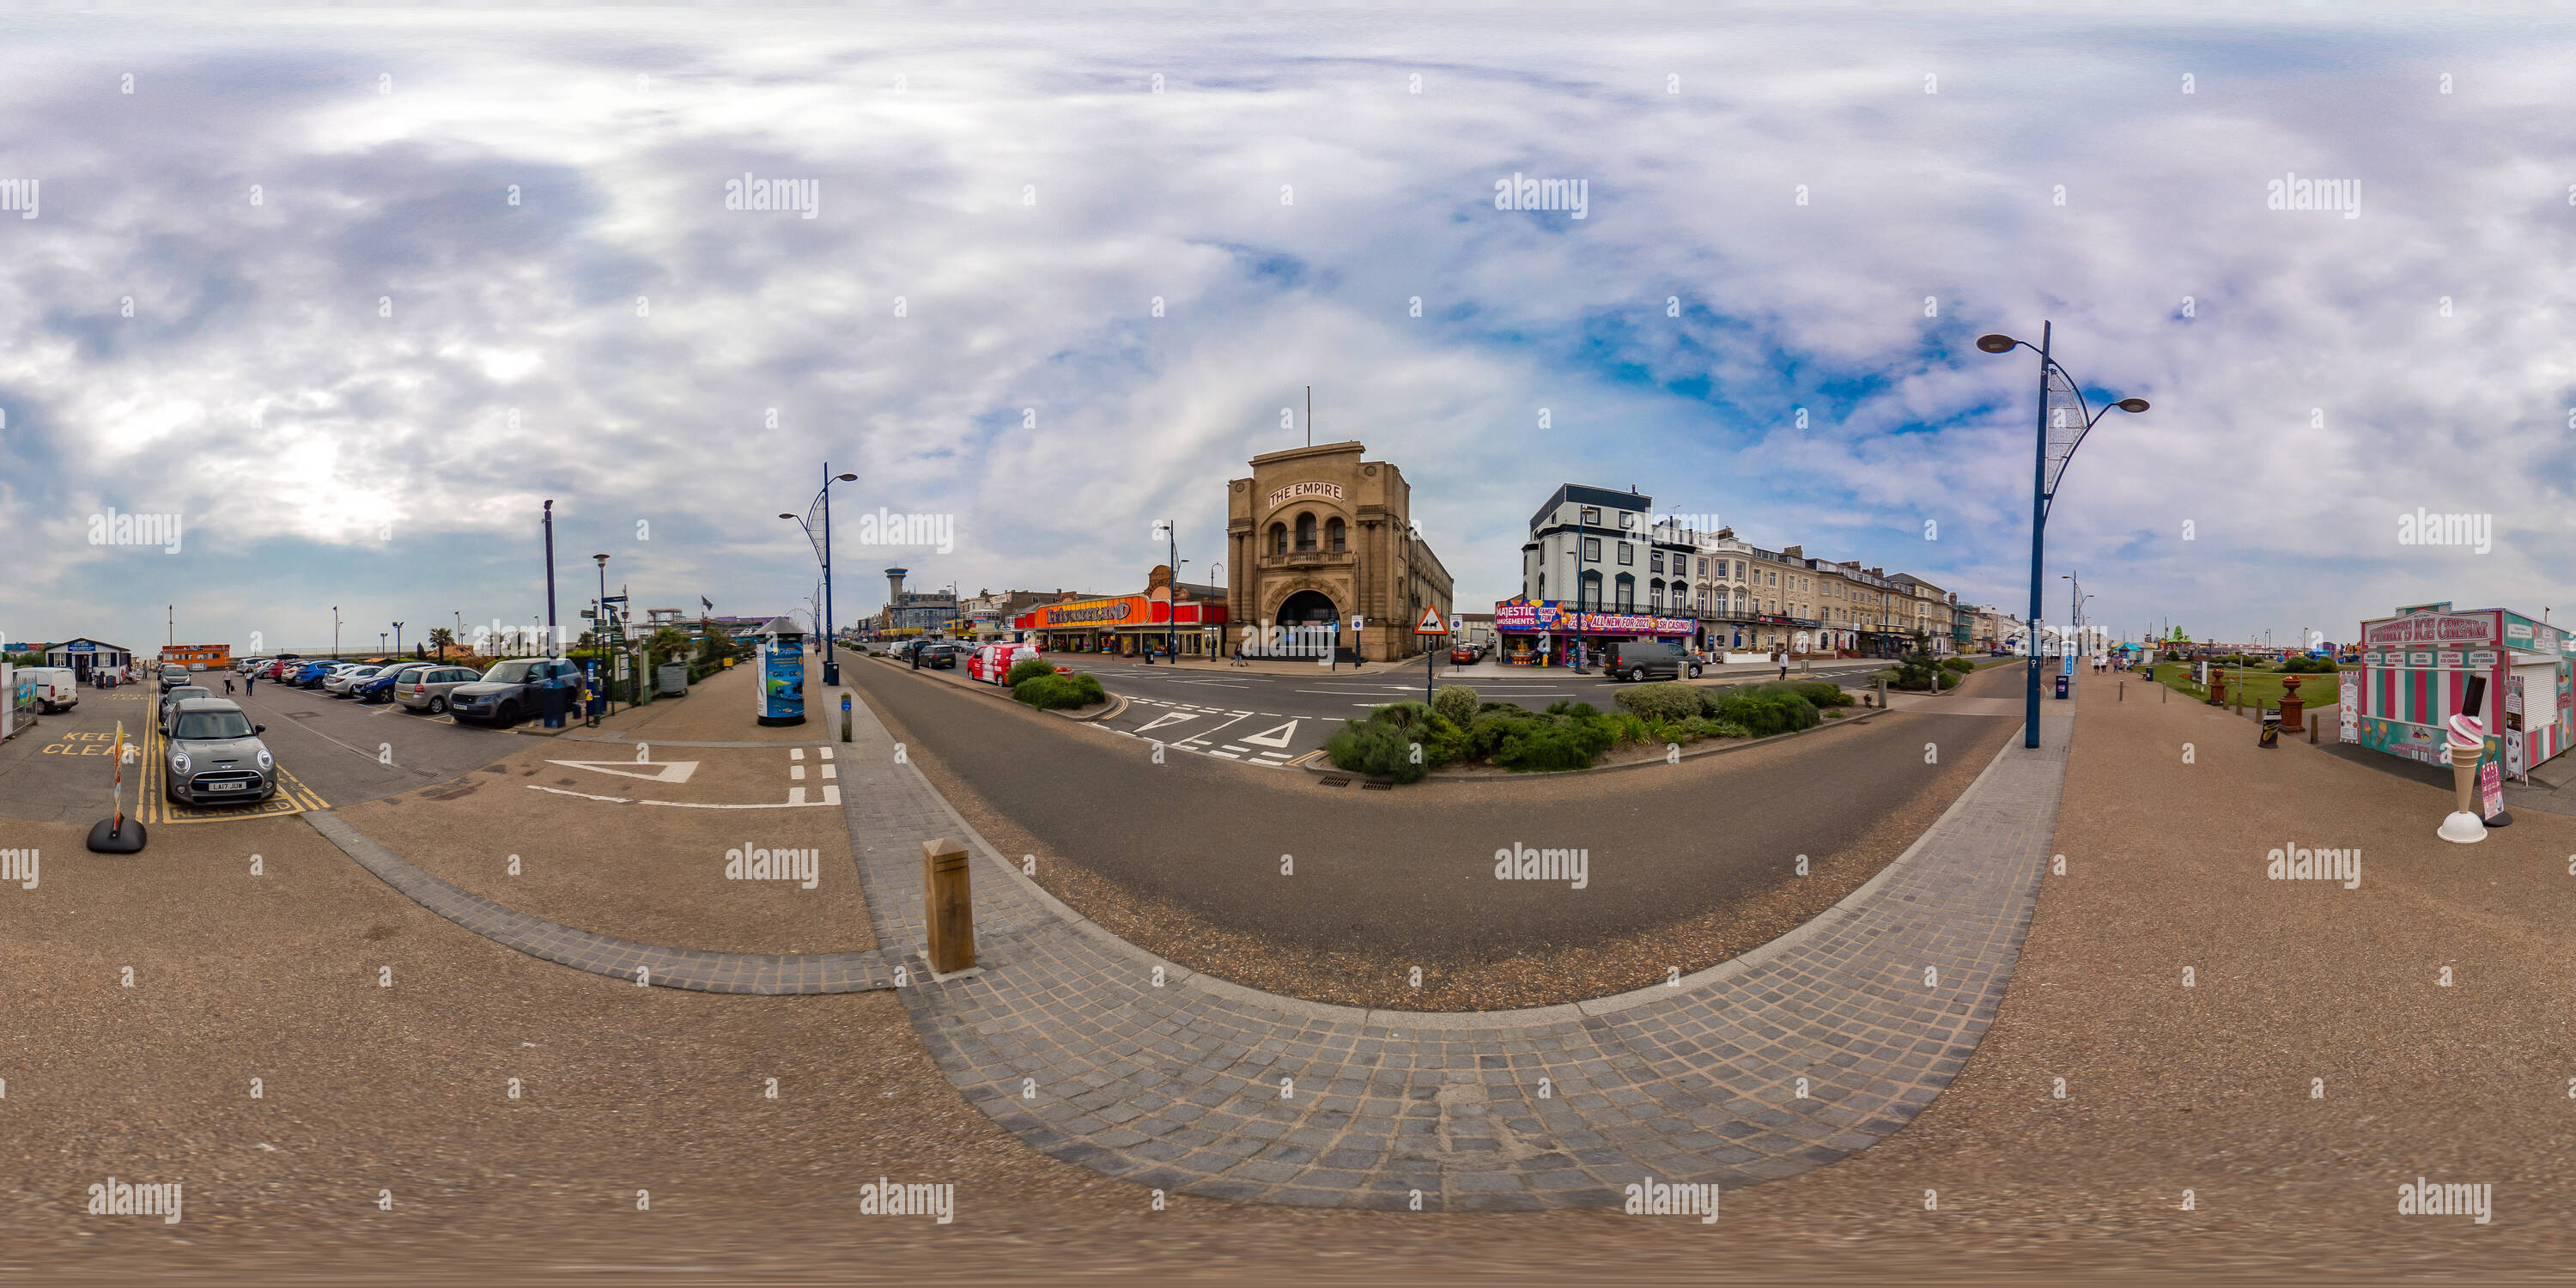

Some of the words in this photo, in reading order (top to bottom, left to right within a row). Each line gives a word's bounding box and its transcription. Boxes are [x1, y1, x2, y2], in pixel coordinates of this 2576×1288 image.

[1270, 487, 1291, 506] THE
[1295, 483, 1341, 499] EMPIRE
[1046, 602, 1131, 624] LEISURELAND
[1496, 605, 1535, 618] MAJESTIC
[1539, 607, 1557, 616] FAMILY
[1591, 616, 1605, 627] ALL
[1606, 617, 1621, 627] NEW
[1621, 617, 1635, 628] FOR
[1635, 618, 1649, 628] 2021
[1668, 620, 1689, 630] CASINO
[2369, 618, 2413, 642] PERRY'S
[2414, 617, 2436, 641] ICE
[2437, 617, 2488, 640] CREAM
